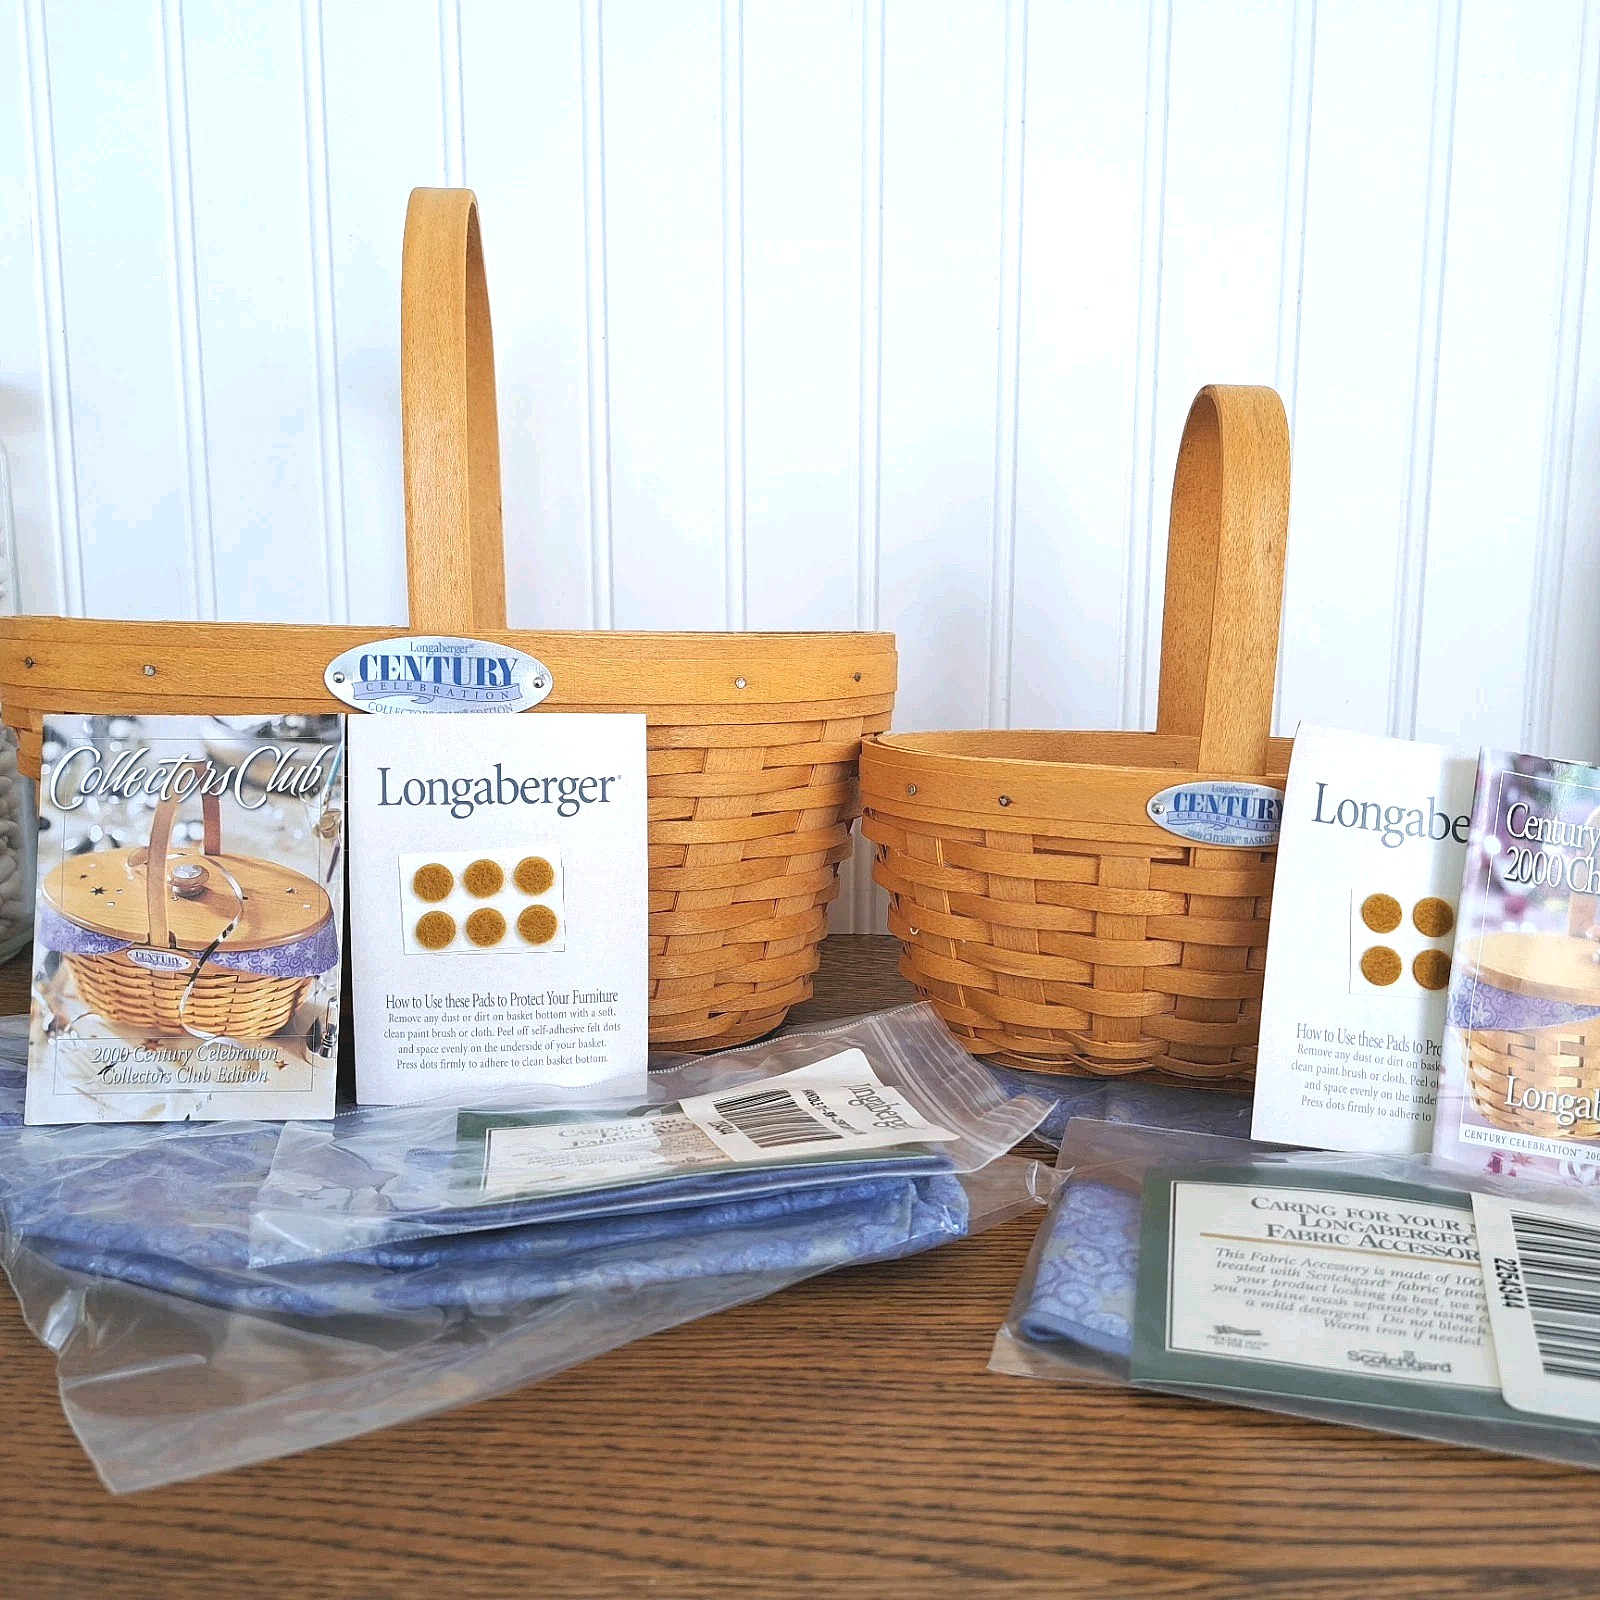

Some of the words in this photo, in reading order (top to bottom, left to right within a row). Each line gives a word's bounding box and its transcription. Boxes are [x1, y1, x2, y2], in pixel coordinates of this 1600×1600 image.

[359, 654, 519, 687] CENTURY
[366, 681, 510, 700] CELEBRATION
[50, 745, 236, 810] Collectors
[235, 744, 334, 810] Club
[377, 762, 616, 819] Longaberger
[1177, 813, 1280, 831] CELEBRATION
[1311, 782, 1470, 849] Longabe
[1506, 802, 1600, 859] Century
[1504, 846, 1563, 887] 2000
[386, 994, 410, 1009] How
[412, 996, 422, 1009] to
[425, 993, 443, 1008] Use
[445, 993, 470, 1008] these
[472, 992, 495, 1008] Pads
[497, 995, 508, 1007] to
[510, 992, 545, 1007] Protect
[547, 990, 570, 1006] Your
[572, 988, 619, 1004] Furniture
[388, 1013, 422, 1023] Remove
[424, 1015, 439, 1025] any
[441, 1012, 460, 1022] dust
[474, 1011, 490, 1022] dirt
[506, 1010, 533, 1021] basket
[535, 1009, 567, 1020] bottom
[569, 1007, 589, 1018] with
[383, 1028, 406, 1039] clean
[407, 1029, 429, 1041] paint
[431, 1027, 457, 1038] brush
[497, 1026, 514, 1036] Peel
[516, 1025, 530, 1036] off
[531, 1023, 585, 1035] self-adhesive
[587, 1022, 601, 1033] felt
[603, 1021, 621, 1032] dots
[1296, 1022, 1322, 1040] How
[1324, 1028, 1335, 1042] to
[1337, 1027, 1356, 1045] Use
[1358, 1030, 1384, 1049] these
[1386, 1034, 1410, 1052] Pads
[1413, 1040, 1423, 1054] to
[91, 1045, 131, 1064] 2000
[132, 1045, 192, 1066] Century
[195, 1043, 278, 1062] Celebration
[398, 1043, 414, 1054] and
[416, 1046, 439, 1056] space
[441, 1042, 468, 1056] evenly
[484, 1042, 498, 1053] the
[500, 1040, 542, 1052] underside
[544, 1039, 555, 1050] of
[556, 1042, 576, 1052] your
[1297, 1043, 1333, 1058] Remove
[1334, 1051, 1351, 1063] any
[1353, 1049, 1372, 1063] dust
[1374, 1056, 1384, 1065] or
[1387, 1054, 1403, 1067] dirt
[1406, 1060, 1418, 1069] on
[101, 1066, 173, 1085] Collectors
[175, 1065, 211, 1084] Club
[216, 1065, 269, 1083] Edition
[397, 1059, 418, 1069] Press
[420, 1058, 438, 1069] dots
[440, 1058, 466, 1071] firmly
[469, 1060, 478, 1068] to
[480, 1057, 509, 1068] adhere
[511, 1059, 520, 1067] to
[521, 1056, 544, 1067] clean
[546, 1055, 573, 1065] basket
[1290, 1058, 1313, 1073] clean
[1316, 1063, 1339, 1077] paint
[1341, 1065, 1367, 1080] brush
[1369, 1073, 1380, 1081] or
[1410, 1074, 1428, 1087] Peel
[1304, 1080, 1322, 1091] and
[1323, 1083, 1348, 1095] space
[1349, 1085, 1379, 1101] evenly
[1380, 1091, 1393, 1100] on
[1395, 1089, 1410, 1102] the
[1301, 1095, 1324, 1108] Press
[1325, 1097, 1346, 1111] dots
[1347, 1100, 1375, 1118] firmly
[1377, 1106, 1387, 1116] to
[1389, 1106, 1420, 1120] adhere
[1422, 1112, 1432, 1122] to
[1464, 1129, 1507, 1145] CENTURY
[1250, 1196, 1337, 1216] CARING
[1346, 1207, 1390, 1223] FOR
[1398, 1213, 1460, 1231] YOUR
[1265, 1223, 1350, 1245] FABRIC
[1299, 1213, 1471, 1246] LONGABERGER
[1215, 1247, 1245, 1260] This
[1251, 1251, 1297, 1266] Fabric
[1301, 1258, 1369, 1276] Accessory
[1374, 1265, 1385, 1275] is
[1390, 1270, 1430, 1281] made
[1435, 1273, 1452, 1284] of
[1216, 1260, 1265, 1273] treated
[1270, 1266, 1300, 1278] with
[1396, 1280, 1441, 1294] fabric
[1211, 1283, 1237, 1293] you
[1243, 1287, 1305, 1301] machine
[1311, 1294, 1348, 1306] wash
[1354, 1300, 1428, 1318] separately
[1433, 1310, 1474, 1323] using
[1235, 1275, 1269, 1284] your
[1272, 1278, 1327, 1293] product
[1332, 1283, 1386, 1300] looking
[1391, 1291, 1408, 1302] its
[1450, 1301, 1470, 1310] we
[1245, 1299, 1255, 1307] a
[1261, 1300, 1295, 1312] mild
[1410, 1318, 1434, 1329] not
[1324, 1317, 1370, 1332] Warm
[1376, 1324, 1407, 1337] iron
[1413, 1330, 1425, 1340] if
